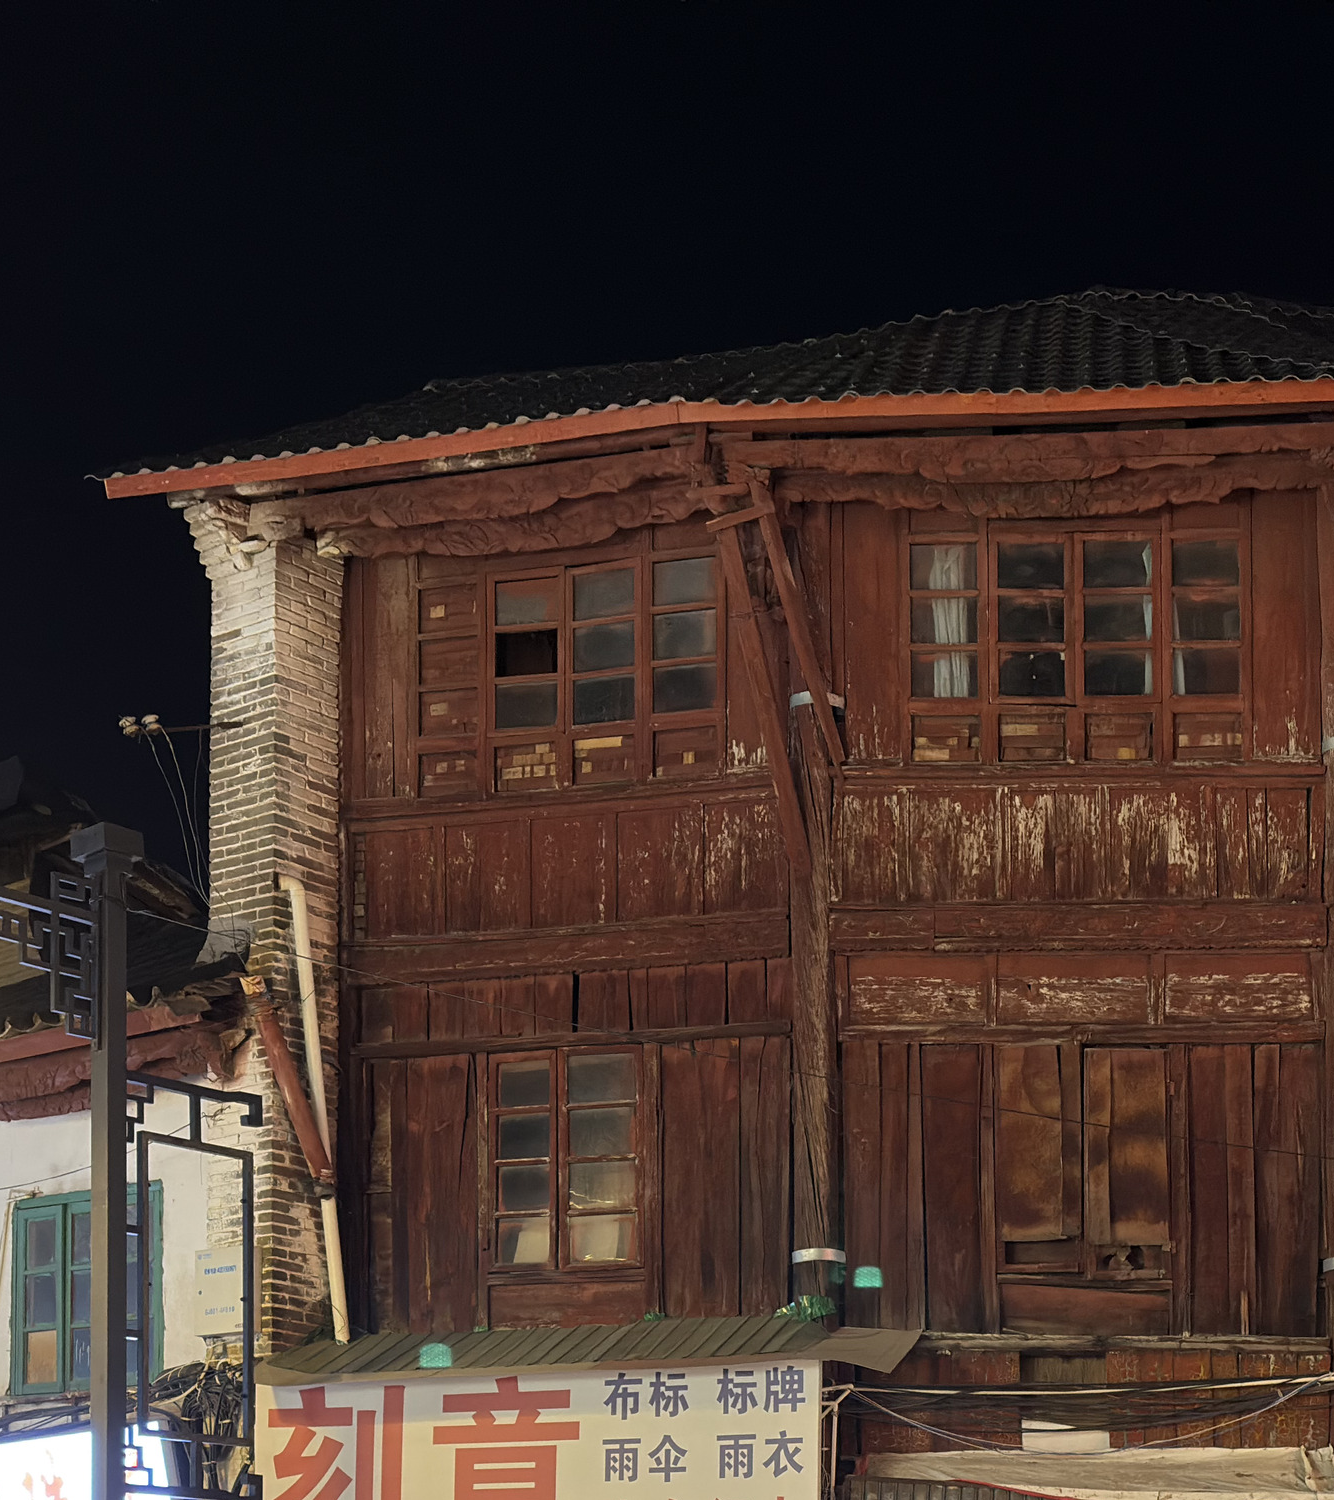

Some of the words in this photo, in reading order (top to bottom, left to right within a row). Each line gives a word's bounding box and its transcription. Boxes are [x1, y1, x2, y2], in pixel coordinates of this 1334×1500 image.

[603, 1372, 688, 1420] 布标
[717, 1366, 806, 1415] 标牌
[602, 1434, 688, 1482] 雨伞
[717, 1430, 804, 1480] 雨衣
